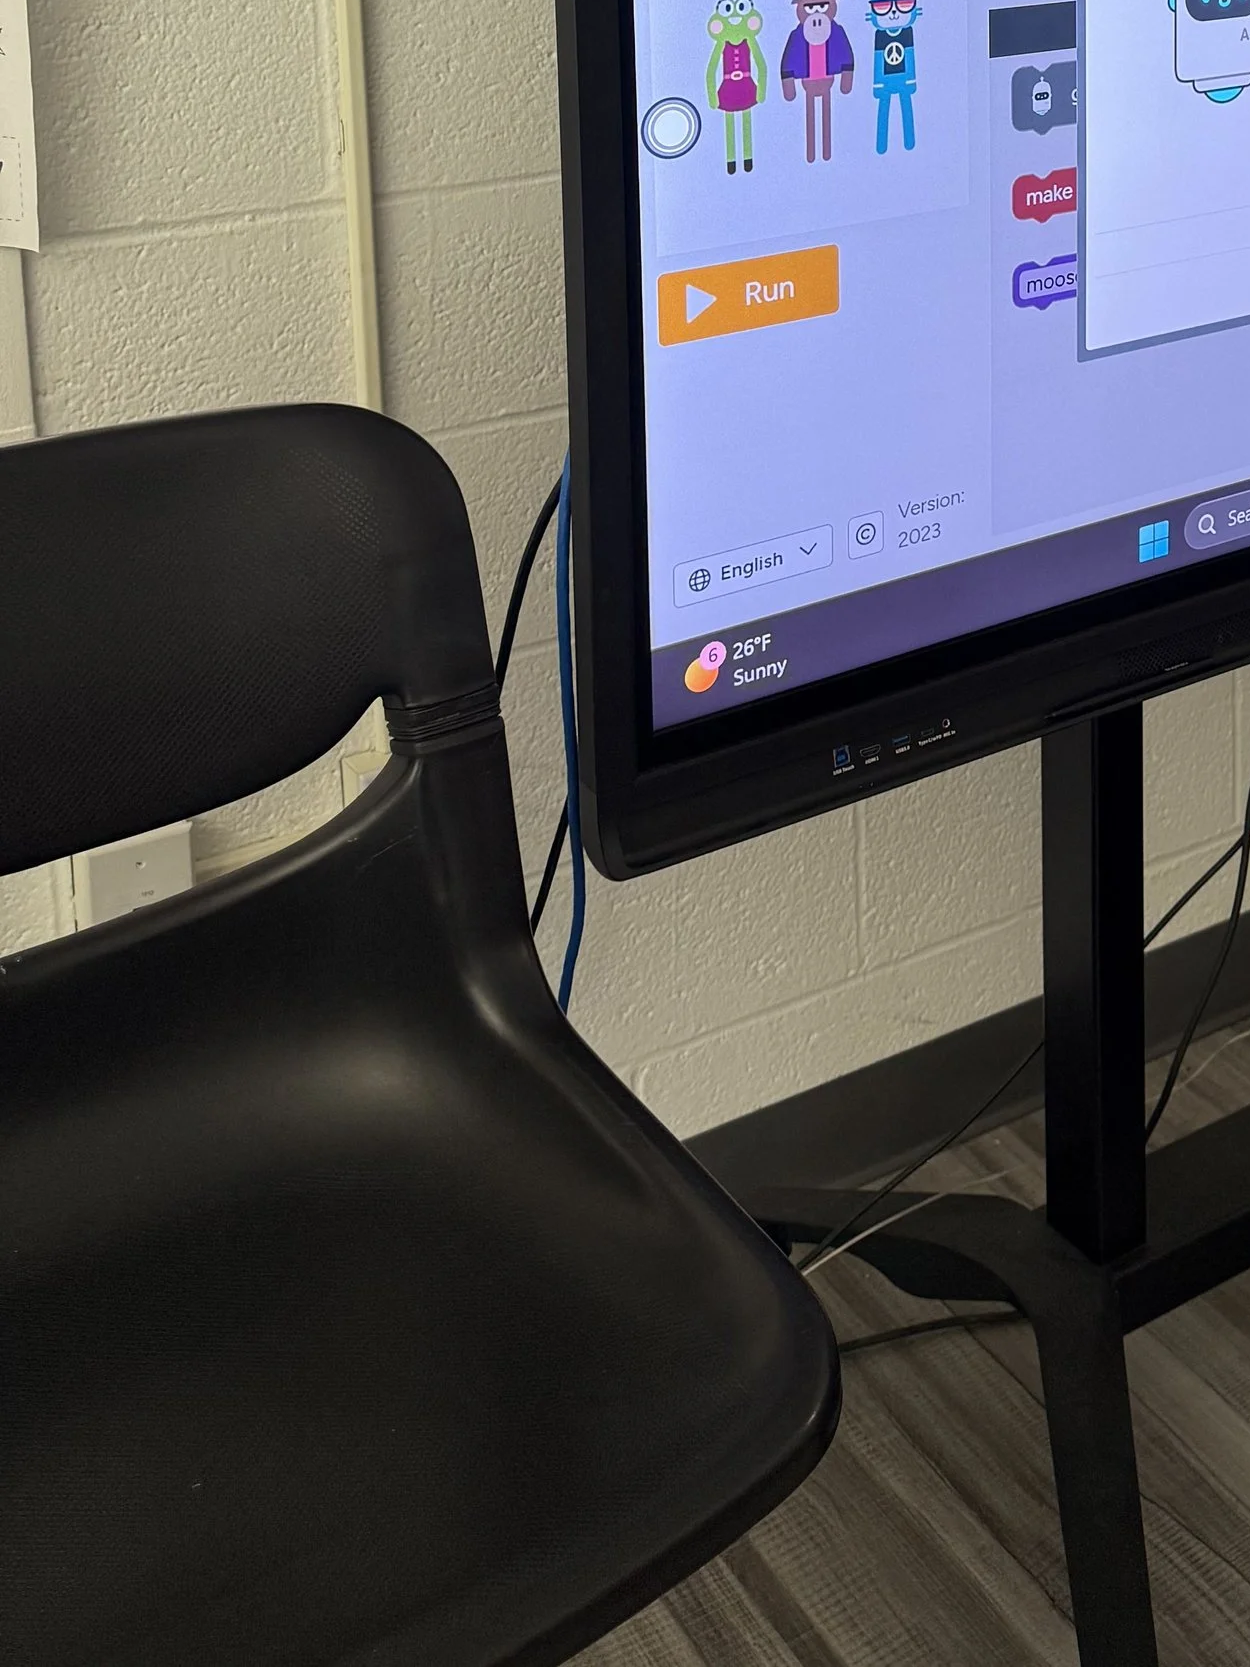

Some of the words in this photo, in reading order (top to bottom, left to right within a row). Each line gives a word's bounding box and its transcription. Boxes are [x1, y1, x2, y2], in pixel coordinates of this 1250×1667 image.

[1025, 183, 1074, 207] make
[744, 279, 795, 307] Run
[897, 488, 966, 520] Version:
[897, 522, 942, 549] 2023
[720, 550, 783, 582] English
[708, 647, 718, 662] 6
[733, 658, 788, 687] Sunny
